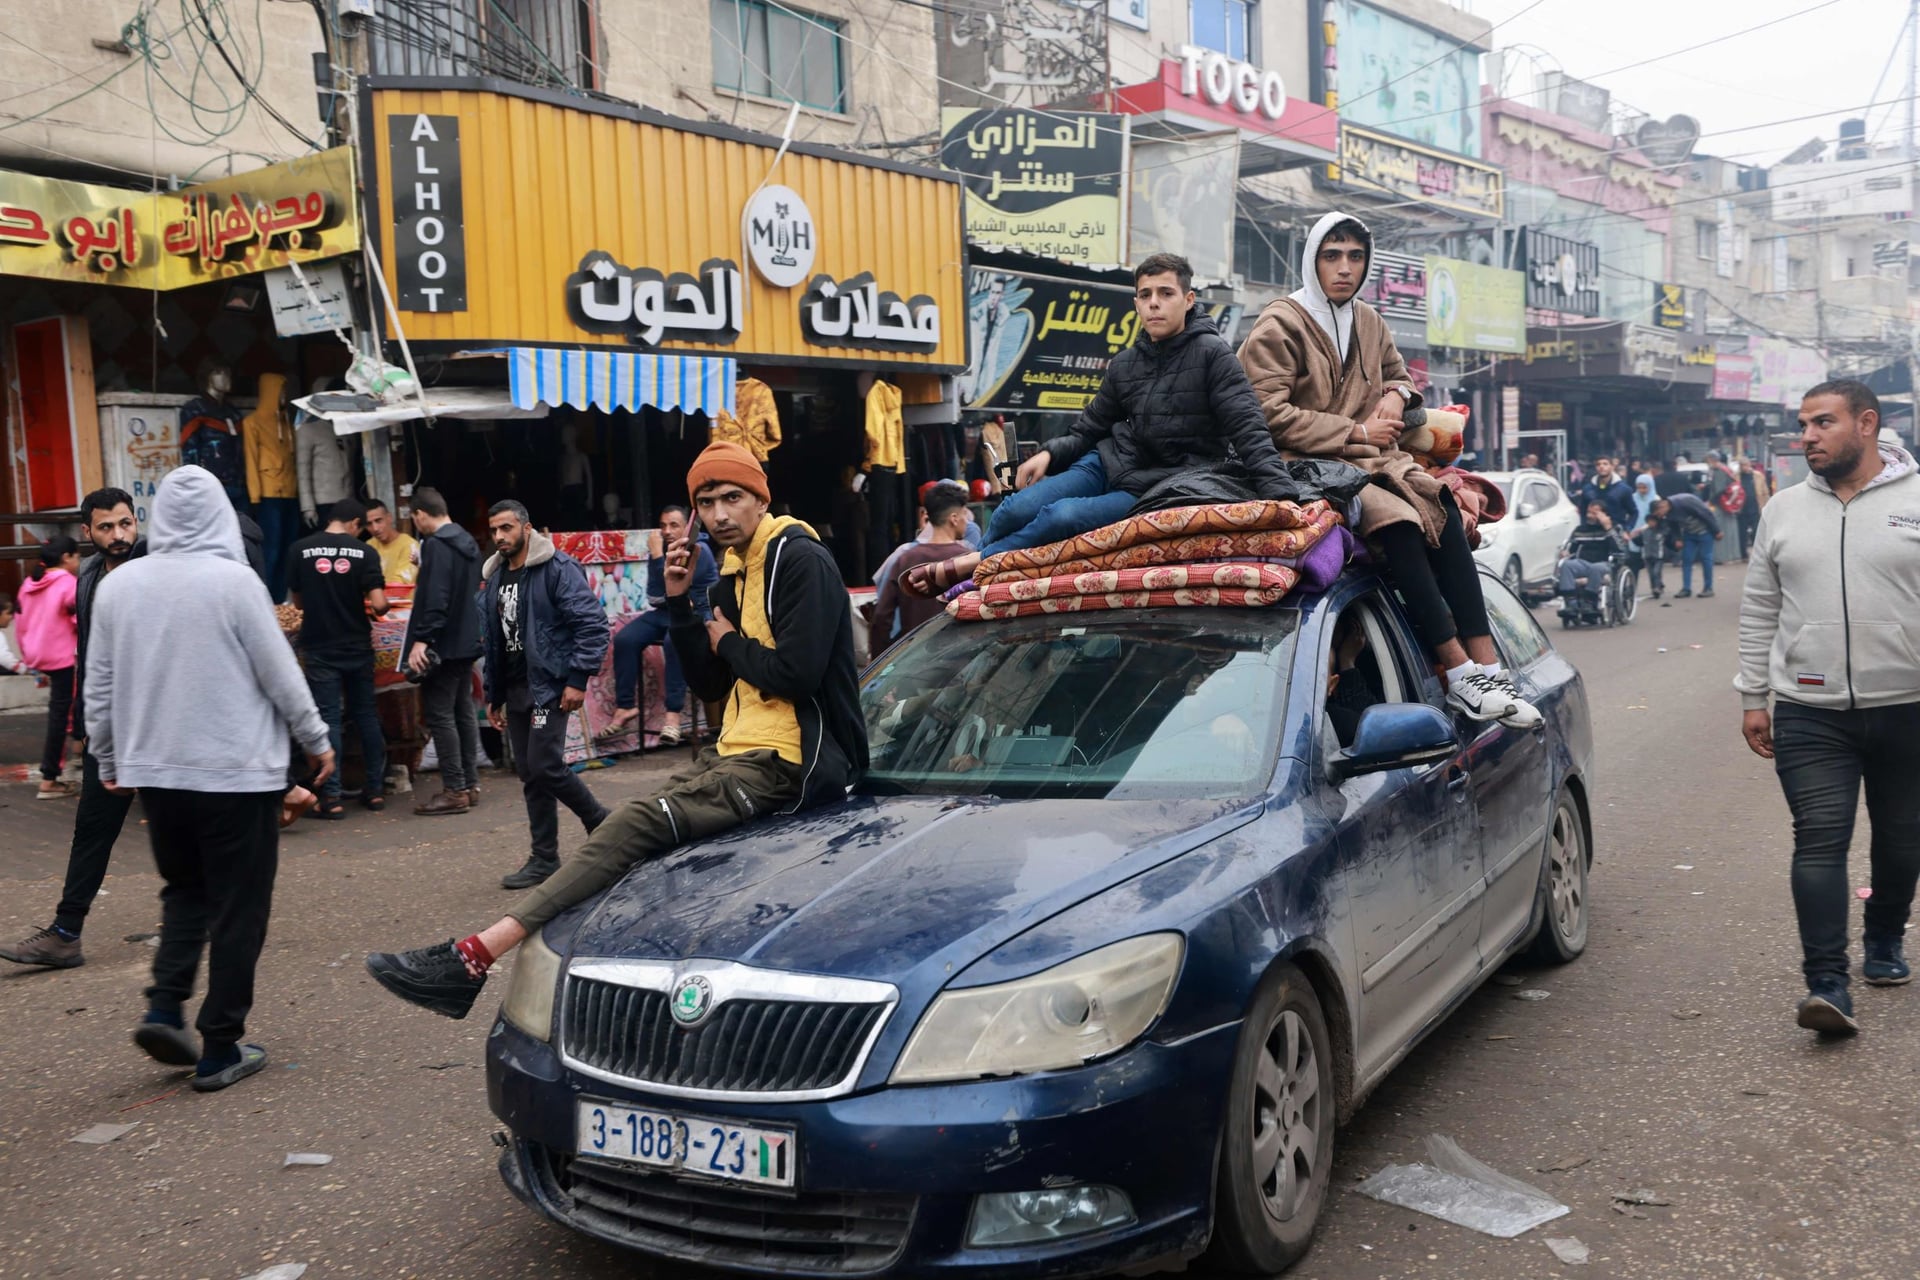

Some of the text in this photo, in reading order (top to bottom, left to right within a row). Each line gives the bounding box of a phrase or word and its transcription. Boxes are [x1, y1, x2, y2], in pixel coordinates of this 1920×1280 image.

[1181, 46, 1286, 119] TOGO
[967, 114, 1096, 159] العزازي
[410, 114, 447, 312] ALHOOT
[986, 162, 1074, 201] سنتر
[163, 191, 325, 261] مجوهرات
[578, 258, 940, 347] محلات الحوت
[1036, 290, 1110, 341] سنتر
